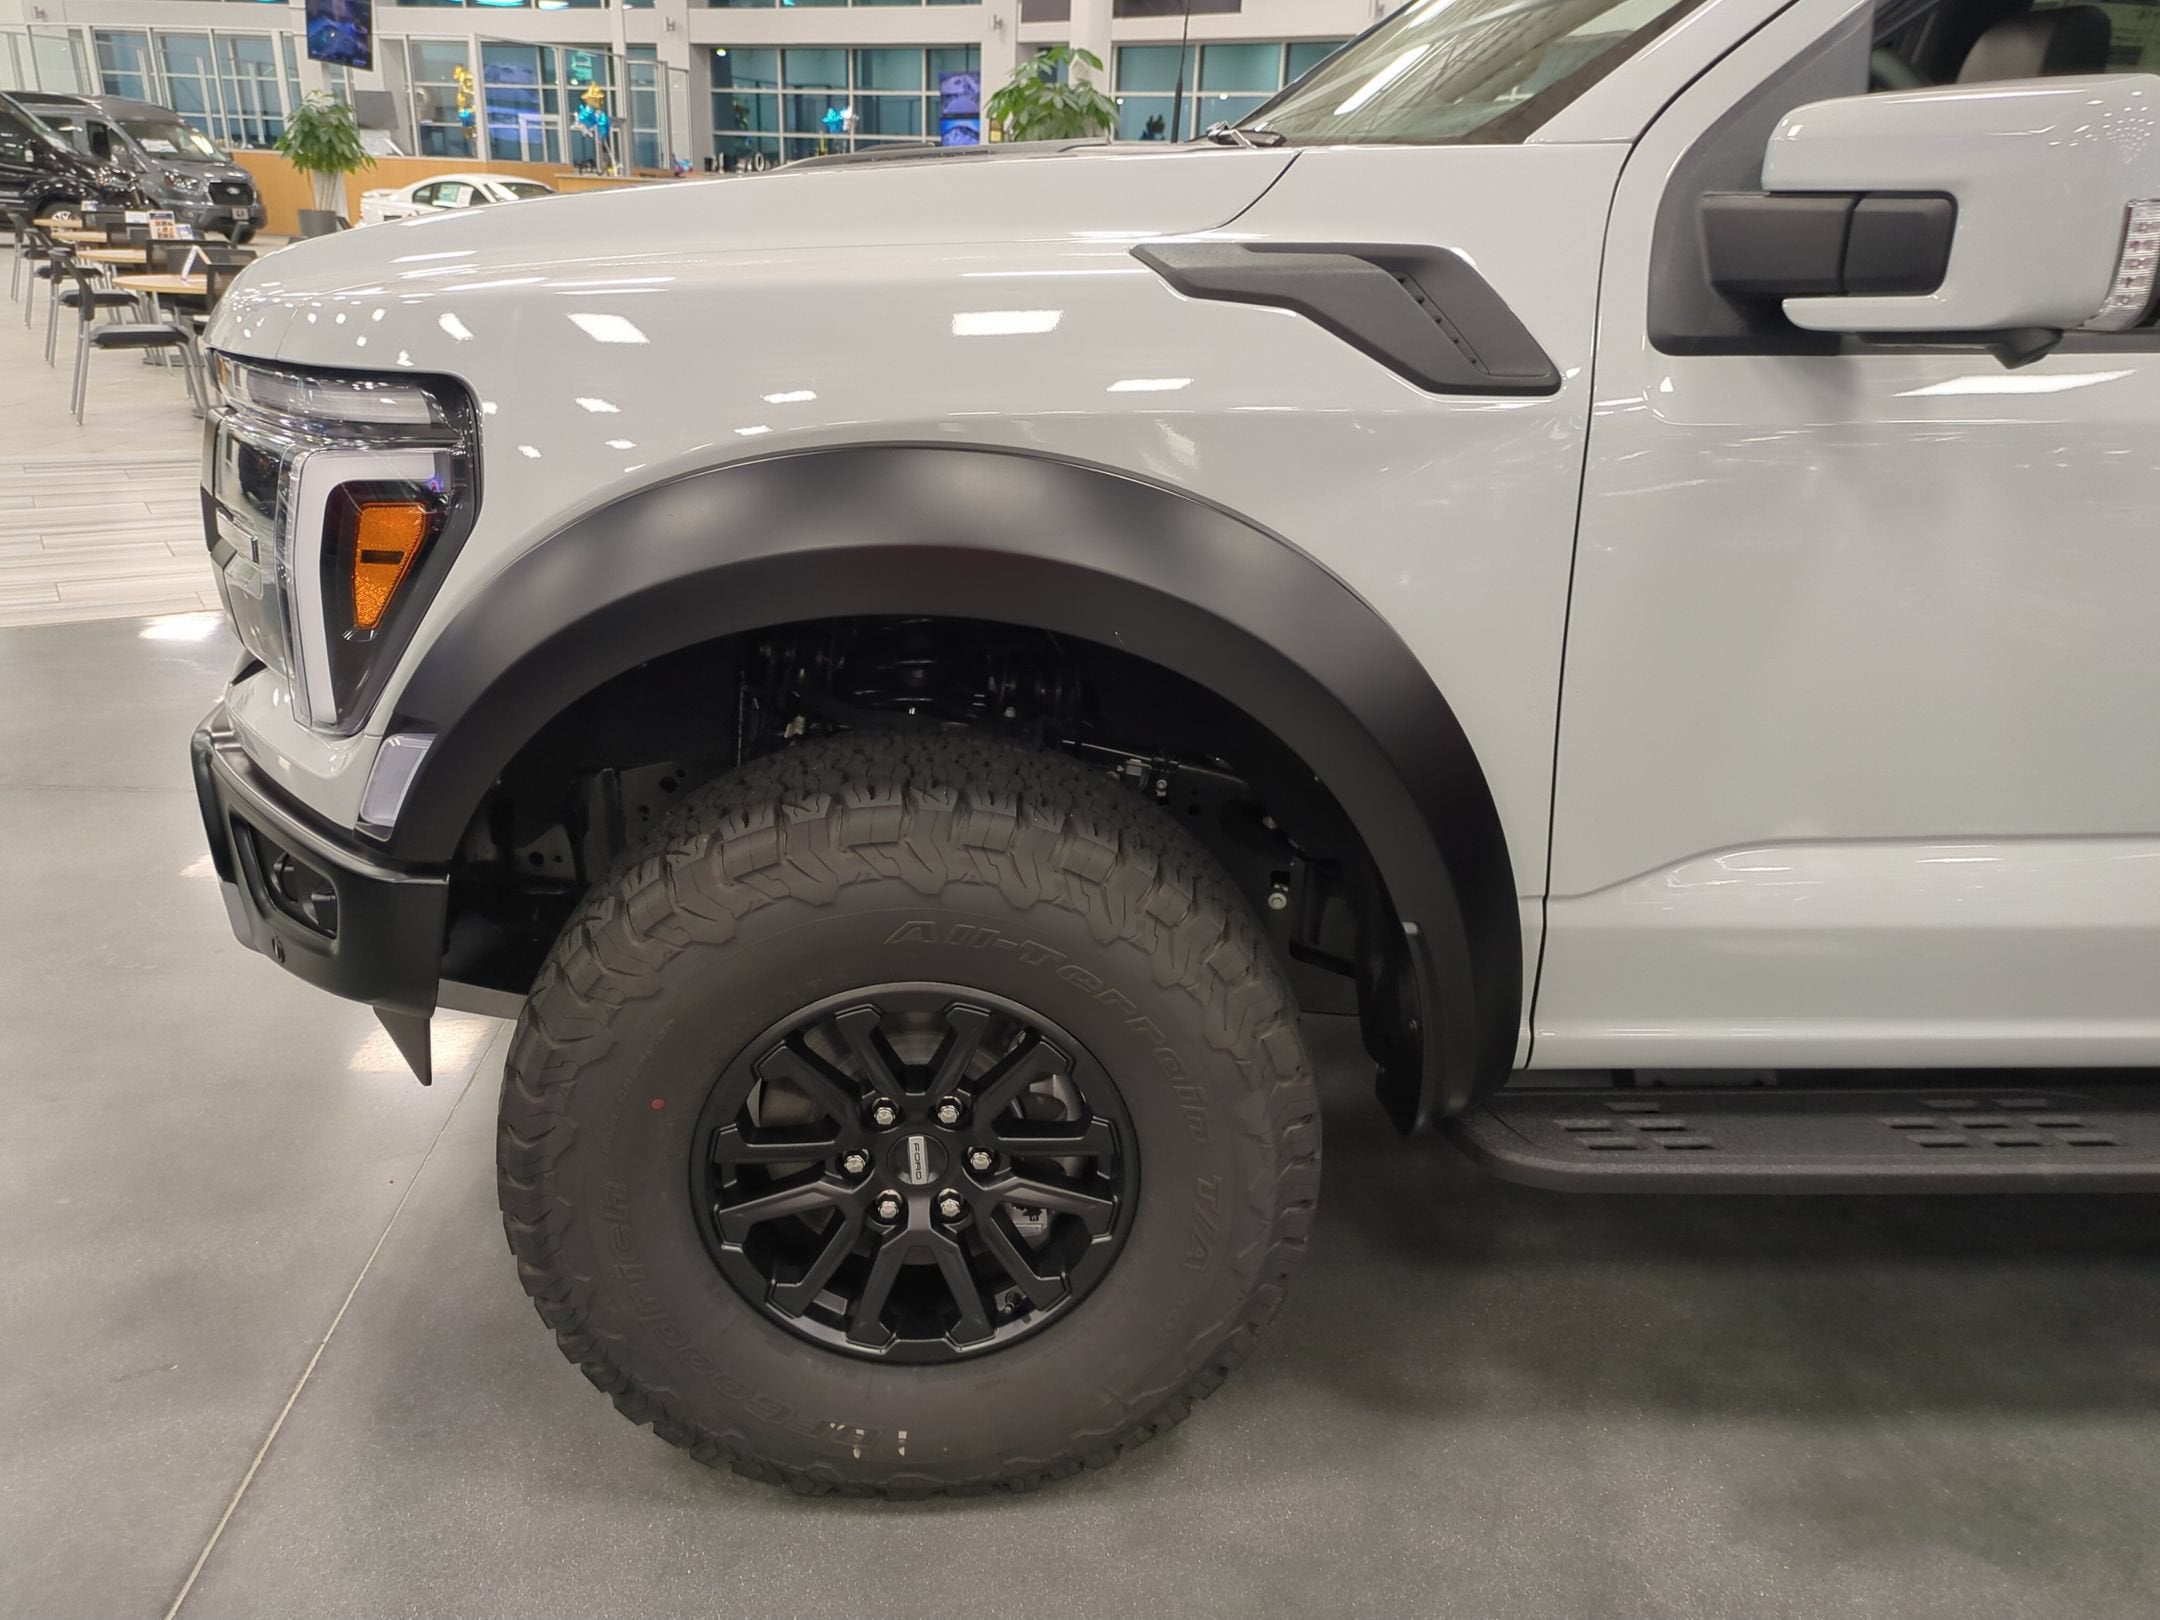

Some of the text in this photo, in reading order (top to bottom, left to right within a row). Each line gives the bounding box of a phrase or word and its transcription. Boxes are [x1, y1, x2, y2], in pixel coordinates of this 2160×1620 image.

[883, 920, 1215, 1147] All-Terrain
[1183, 1174, 1222, 1273] T/A
[913, 1142, 922, 1180] FORD
